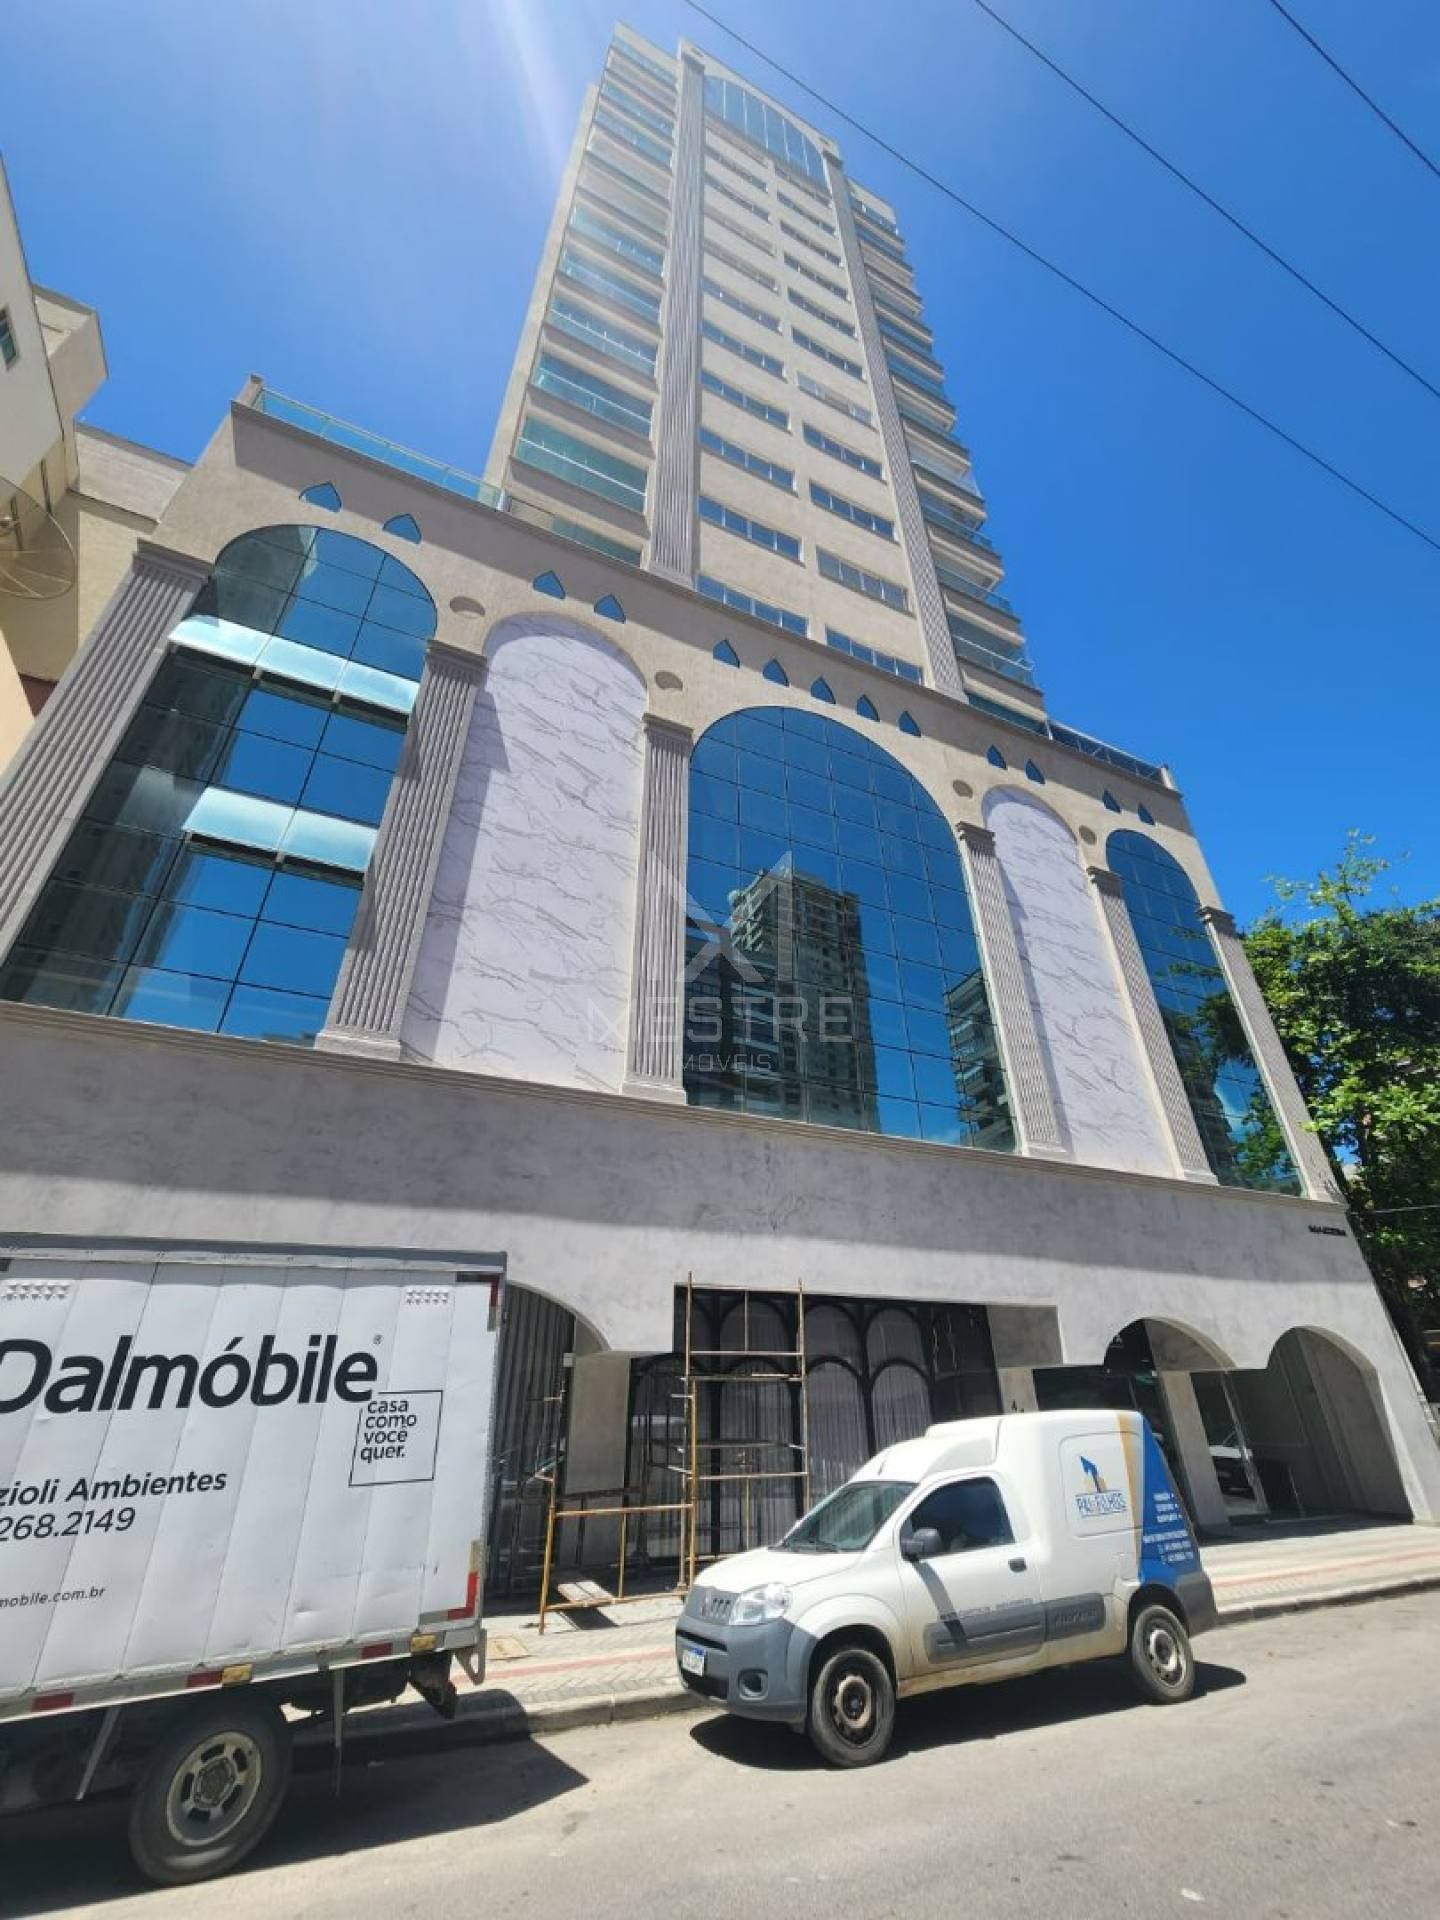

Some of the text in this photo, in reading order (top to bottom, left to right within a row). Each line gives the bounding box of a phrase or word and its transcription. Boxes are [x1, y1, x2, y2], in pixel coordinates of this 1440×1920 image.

[0, 1335, 378, 1414] Dalmóbile
[367, 1400, 409, 1414] casa
[365, 1414, 417, 1429] como
[360, 1445, 406, 1463] quer.
[65, 1471, 228, 1502] Ambientes
[0, 1507, 136, 1542] 268.2149
